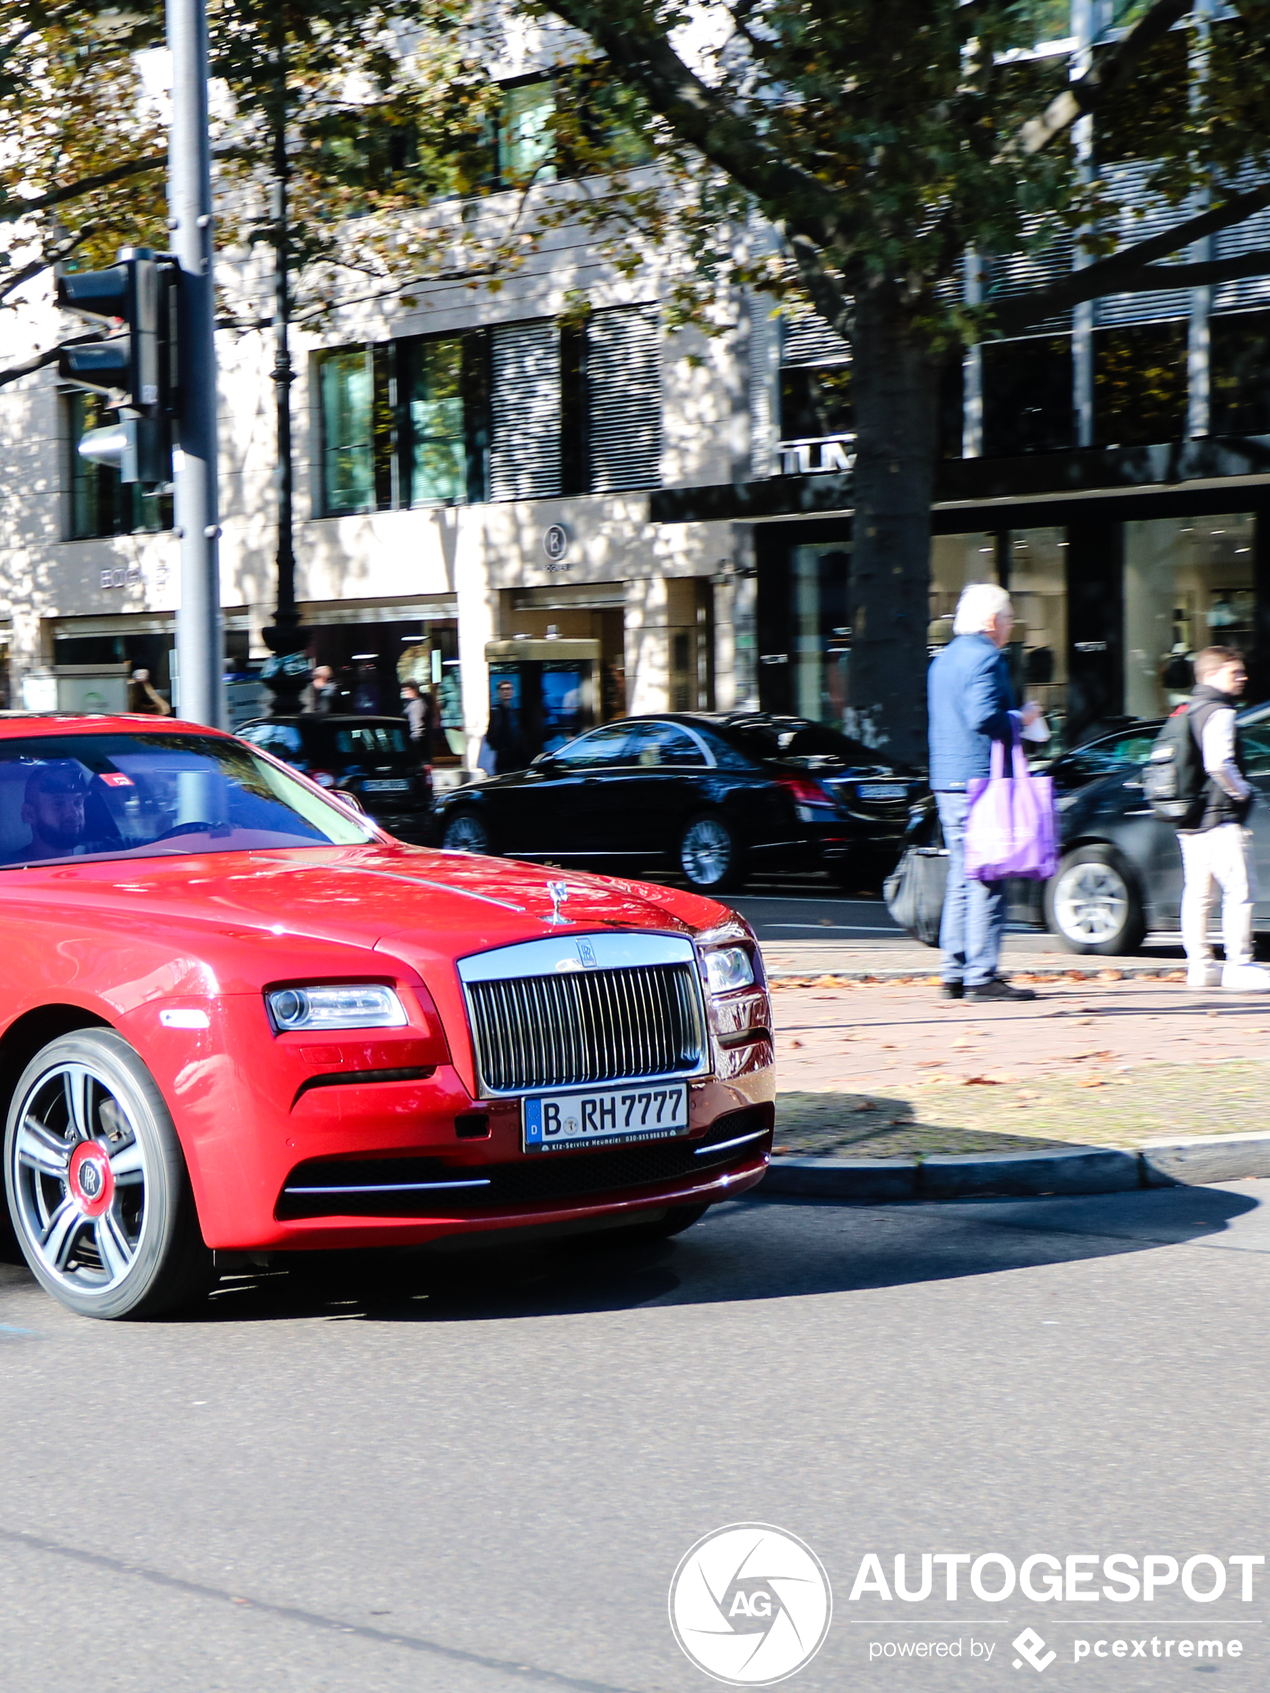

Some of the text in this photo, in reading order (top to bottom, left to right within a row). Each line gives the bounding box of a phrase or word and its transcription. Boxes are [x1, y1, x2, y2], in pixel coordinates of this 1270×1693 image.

[776, 443, 857, 474] TUM
[531, 1124, 538, 1135] D
[543, 1102, 562, 1136] B
